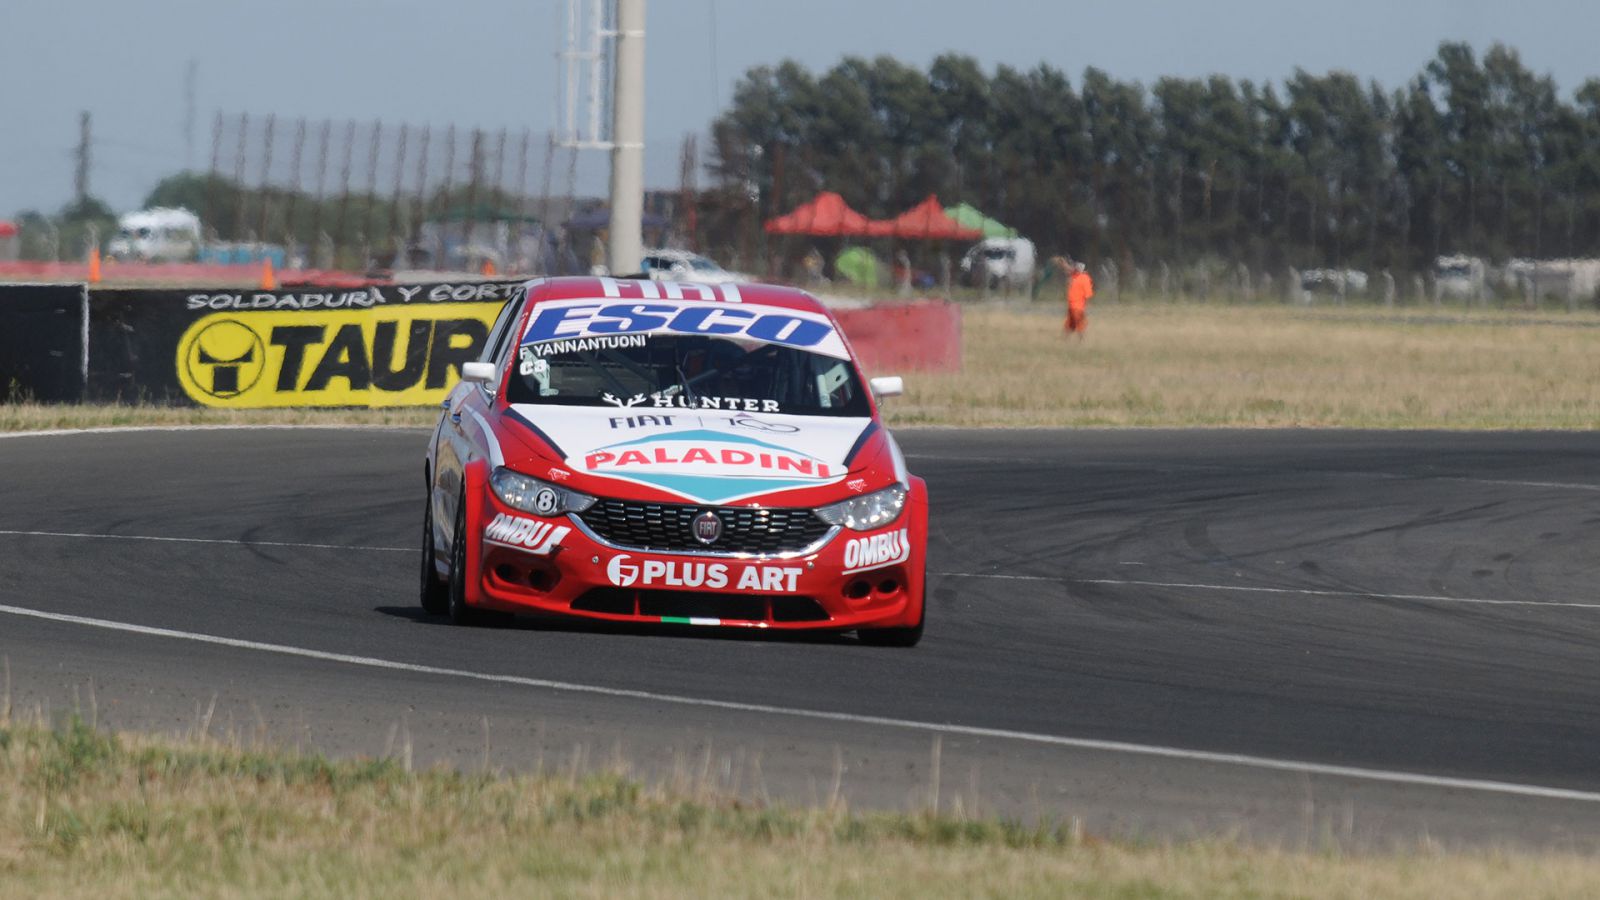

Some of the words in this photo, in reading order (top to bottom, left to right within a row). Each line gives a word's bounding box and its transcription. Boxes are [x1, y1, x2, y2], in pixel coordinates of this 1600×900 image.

[398, 285, 421, 301] Y
[521, 304, 833, 346] ESCO
[270, 319, 489, 392] TAUR
[534, 335, 646, 358] YANNANTUONI
[654, 395, 779, 412] HUNTER
[609, 415, 677, 428] FIAT
[585, 447, 830, 478] PALADINI
[537, 491, 551, 509] 8
[699, 520, 717, 536] FIAT
[643, 560, 728, 588] PLUS
[737, 566, 802, 591] ART
